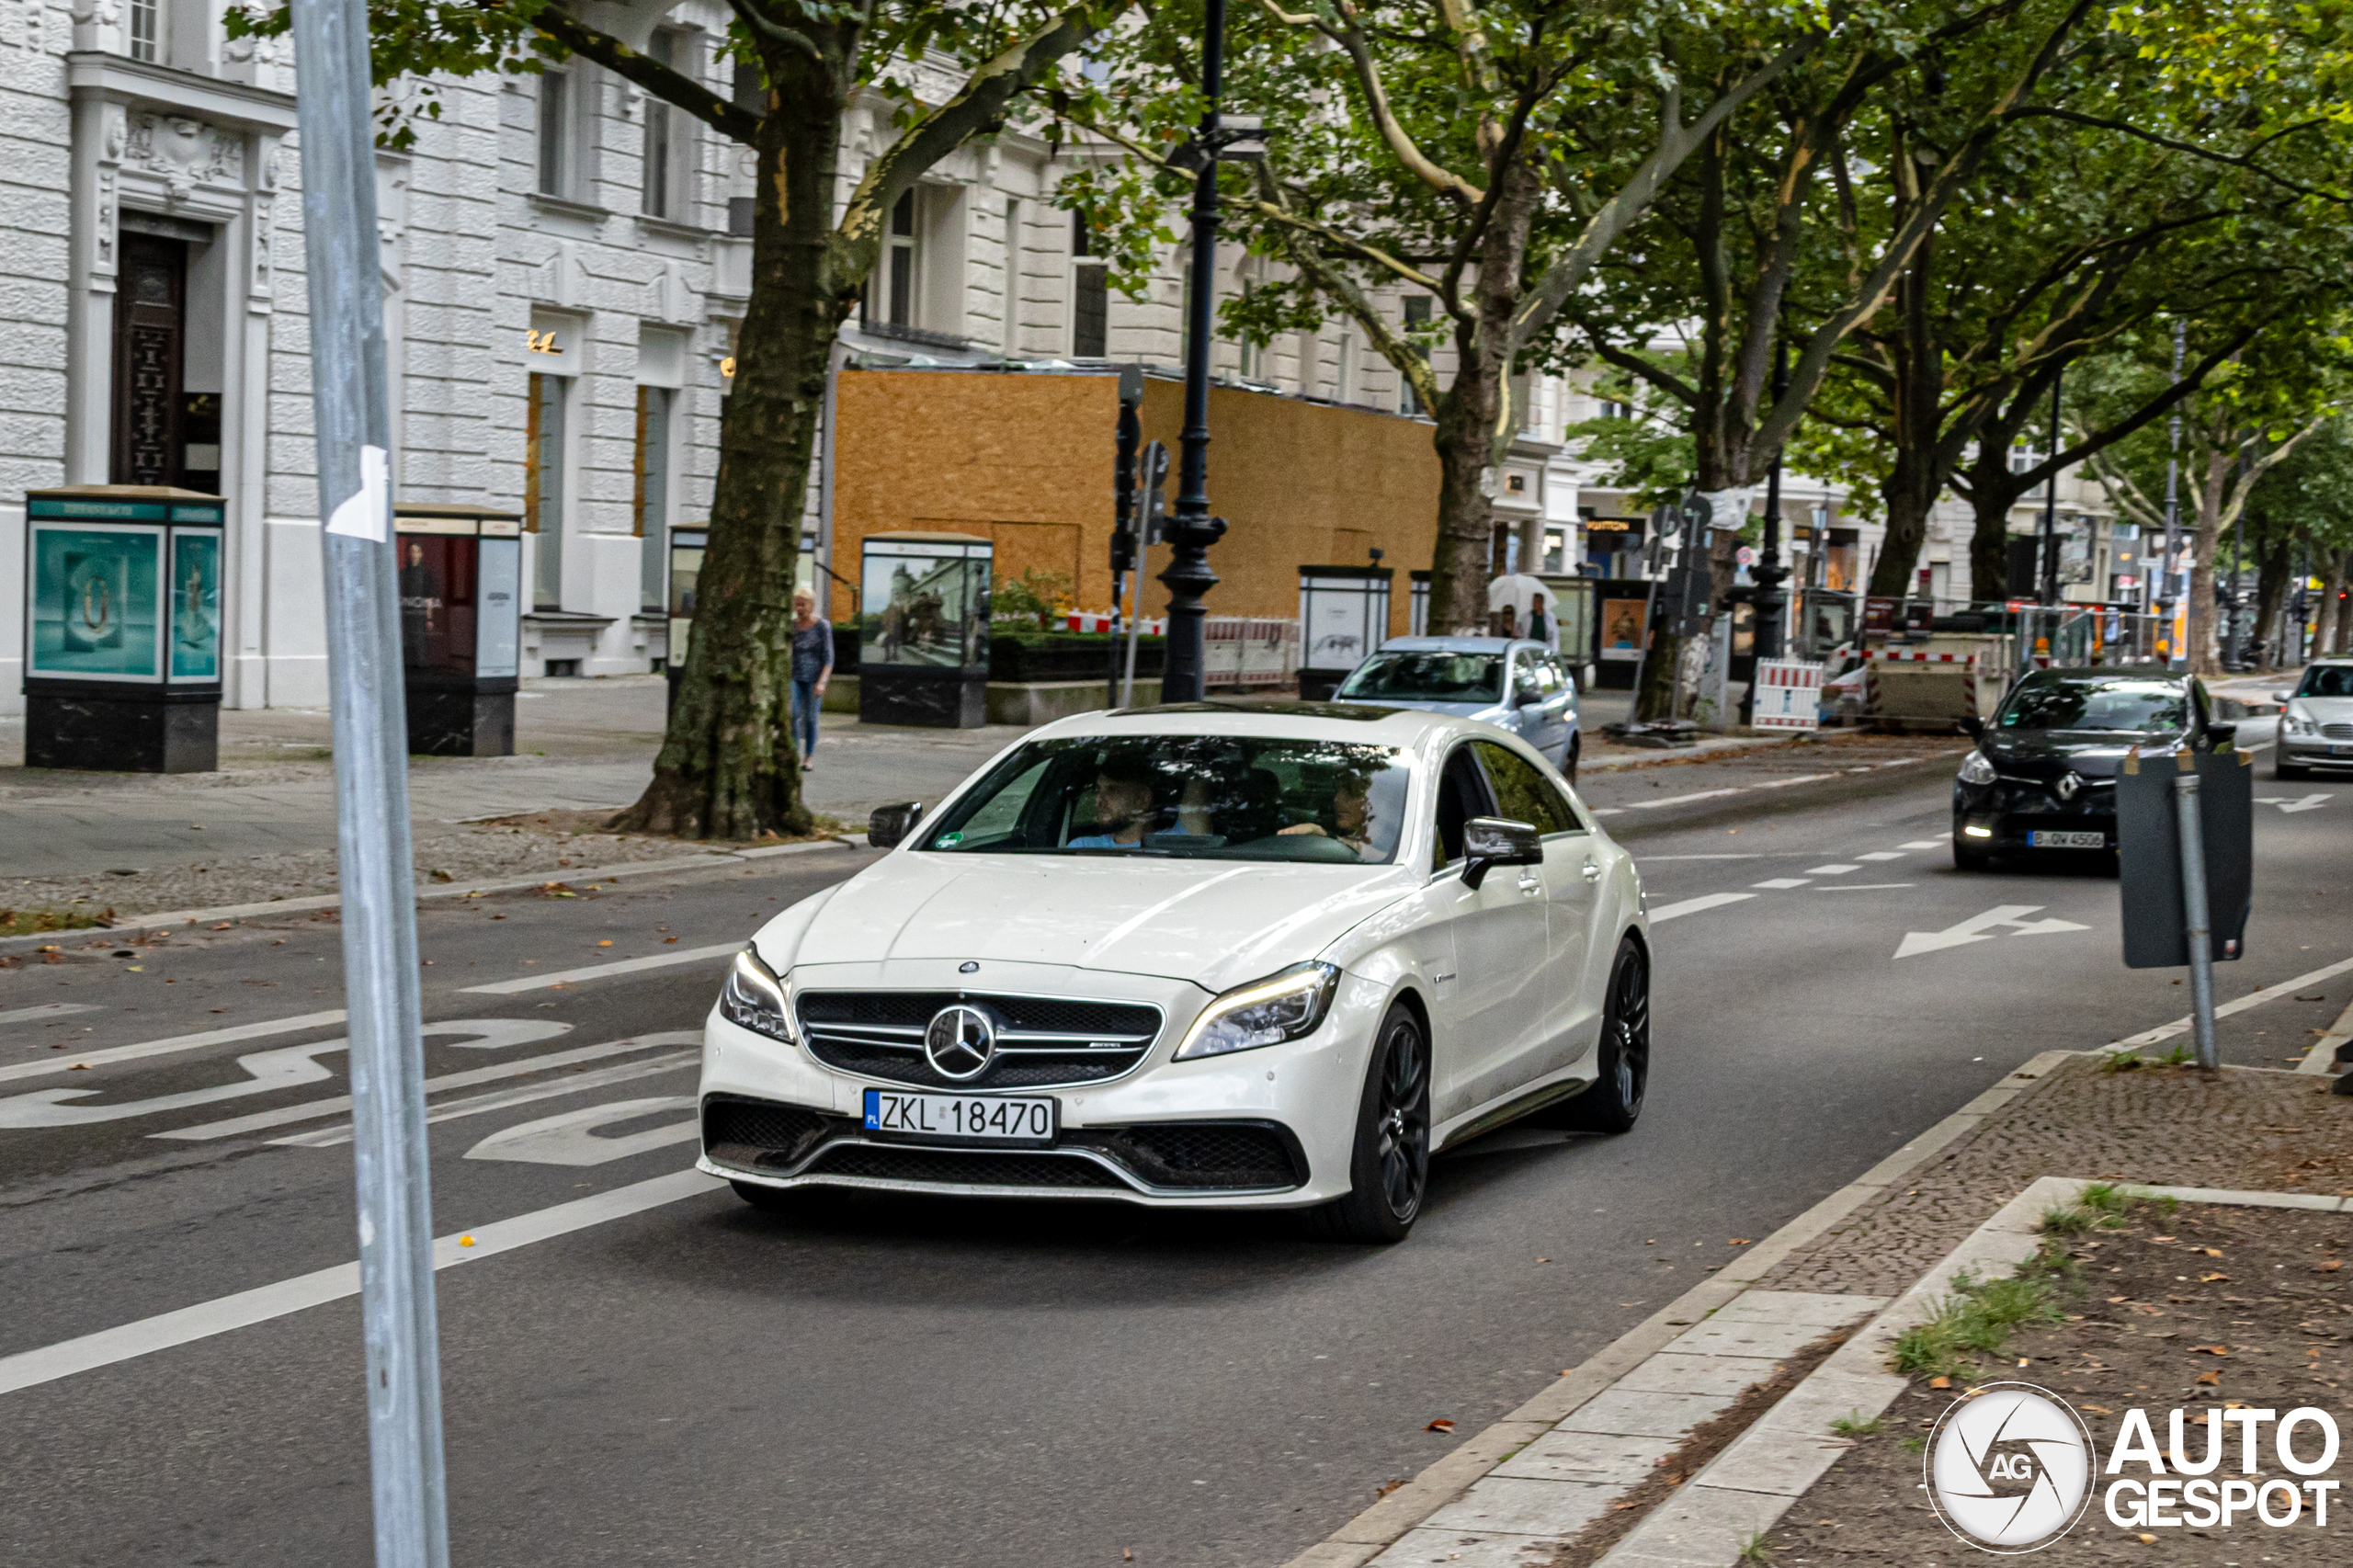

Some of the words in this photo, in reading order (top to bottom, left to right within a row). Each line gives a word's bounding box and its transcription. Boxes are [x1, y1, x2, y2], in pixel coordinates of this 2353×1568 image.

[867, 1114, 879, 1125] PL
[881, 1096, 937, 1131] ZKL
[951, 1100, 1049, 1135] 18470
